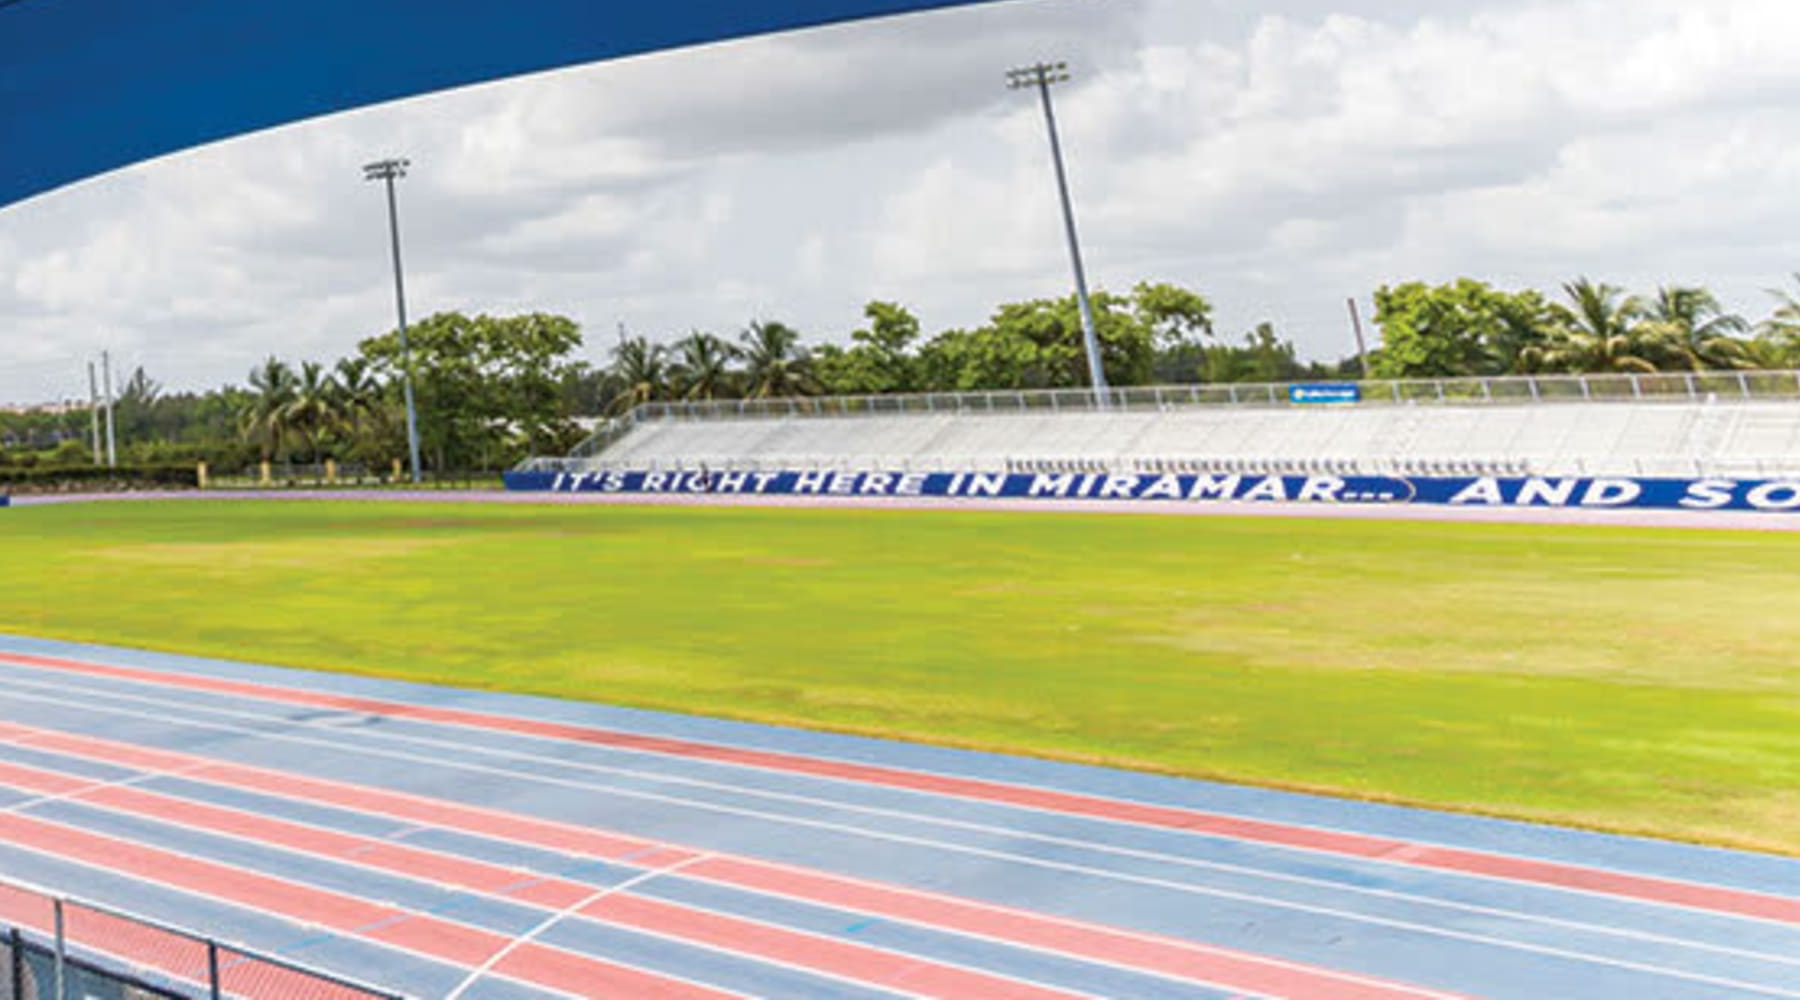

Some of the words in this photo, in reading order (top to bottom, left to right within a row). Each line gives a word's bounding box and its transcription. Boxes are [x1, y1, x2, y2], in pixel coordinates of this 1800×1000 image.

[552, 472, 625, 491] IT'S
[641, 472, 778, 492] RIGHT
[793, 472, 929, 494] HERE
[947, 473, 1006, 495] IN
[1448, 477, 1642, 506] AND
[1678, 480, 1800, 509] SO
